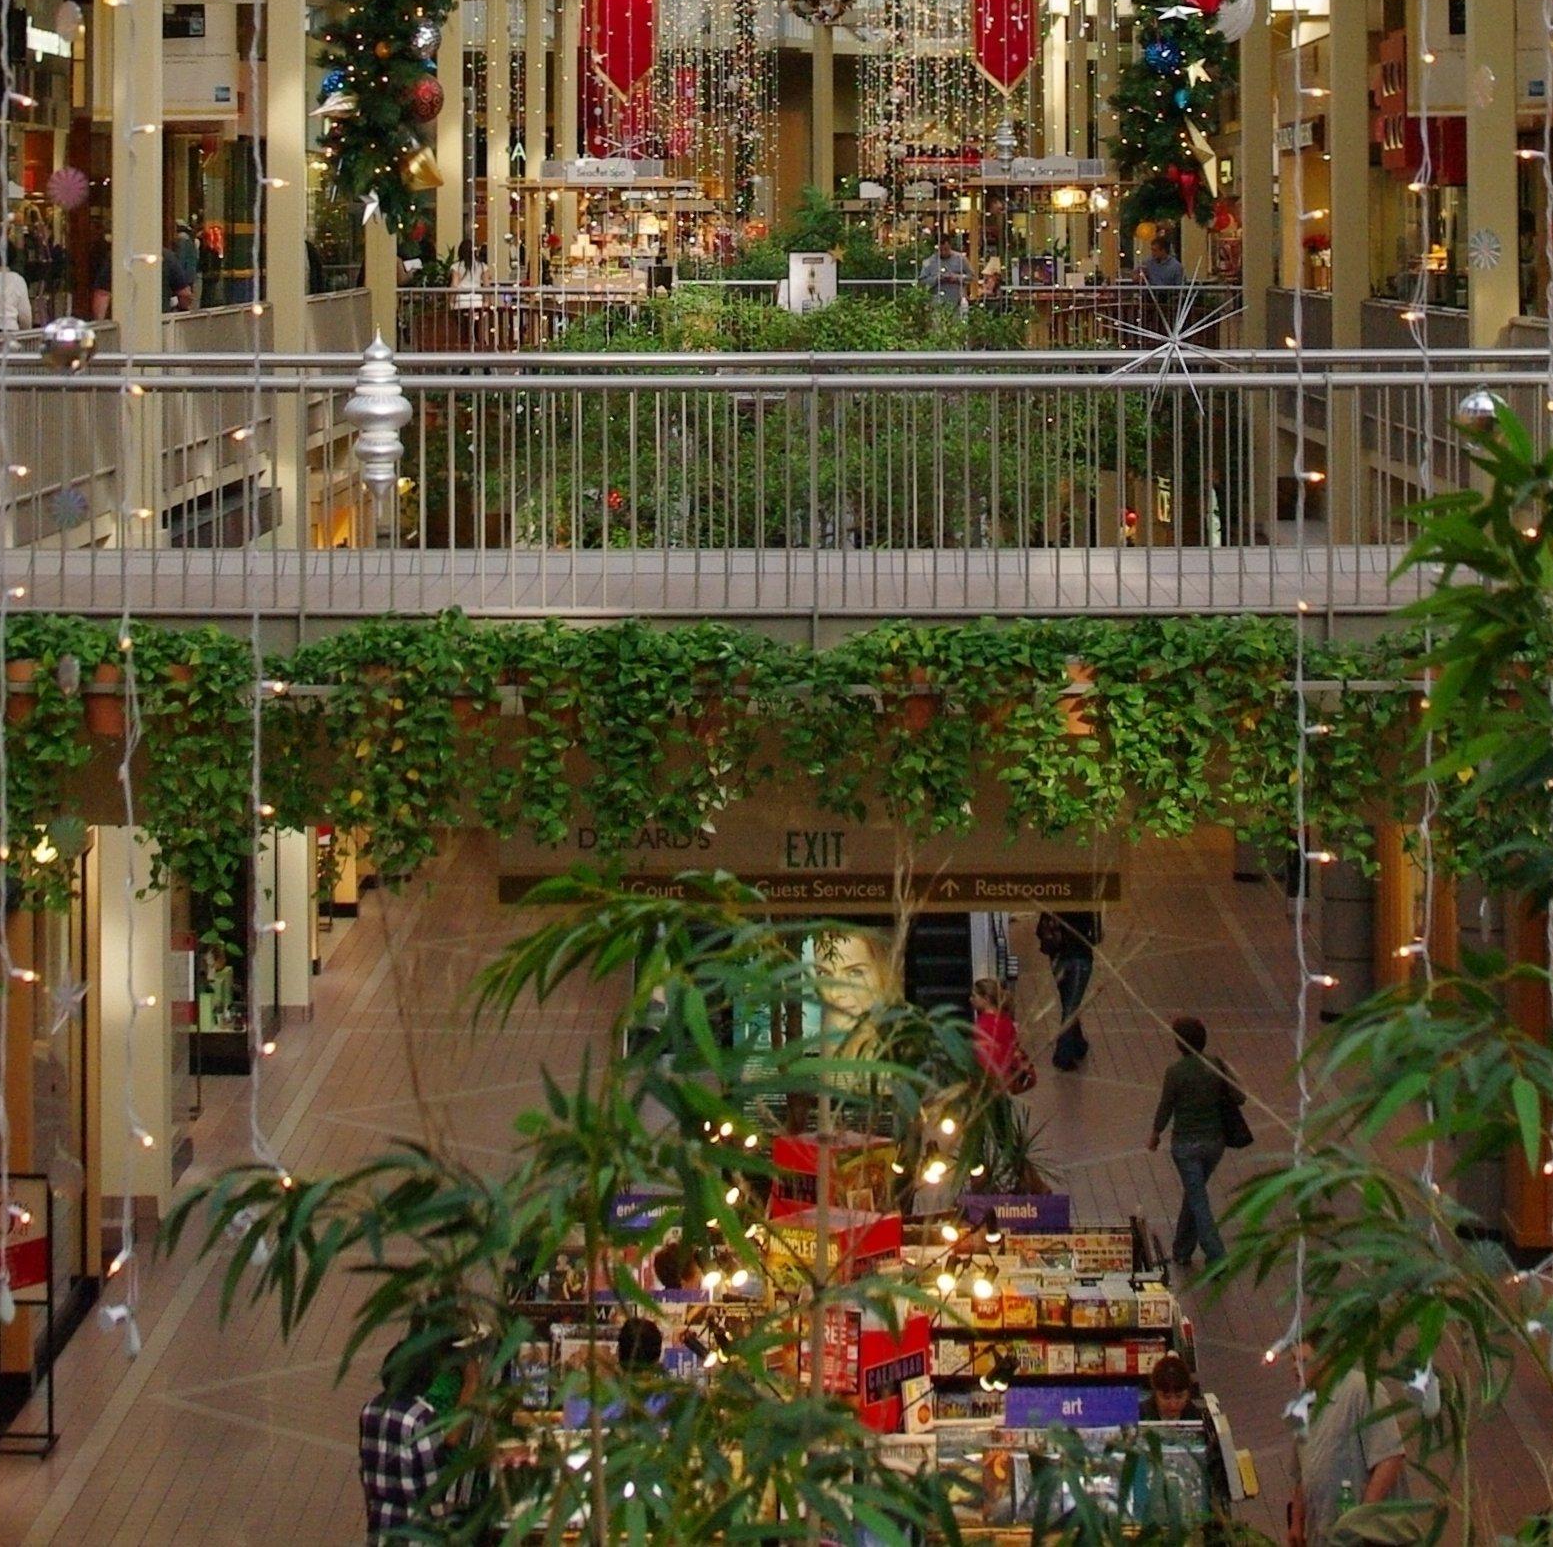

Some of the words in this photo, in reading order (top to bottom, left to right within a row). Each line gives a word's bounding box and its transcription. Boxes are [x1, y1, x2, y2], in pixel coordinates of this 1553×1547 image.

[577, 826, 712, 850] DARD'S
[785, 830, 845, 869] EXIT
[631, 881, 684, 899] Court
[755, 880, 808, 899] Guest
[813, 879, 885, 898] Services
[975, 878, 1072, 897] Restrooms
[1061, 1397, 1084, 1416] art
